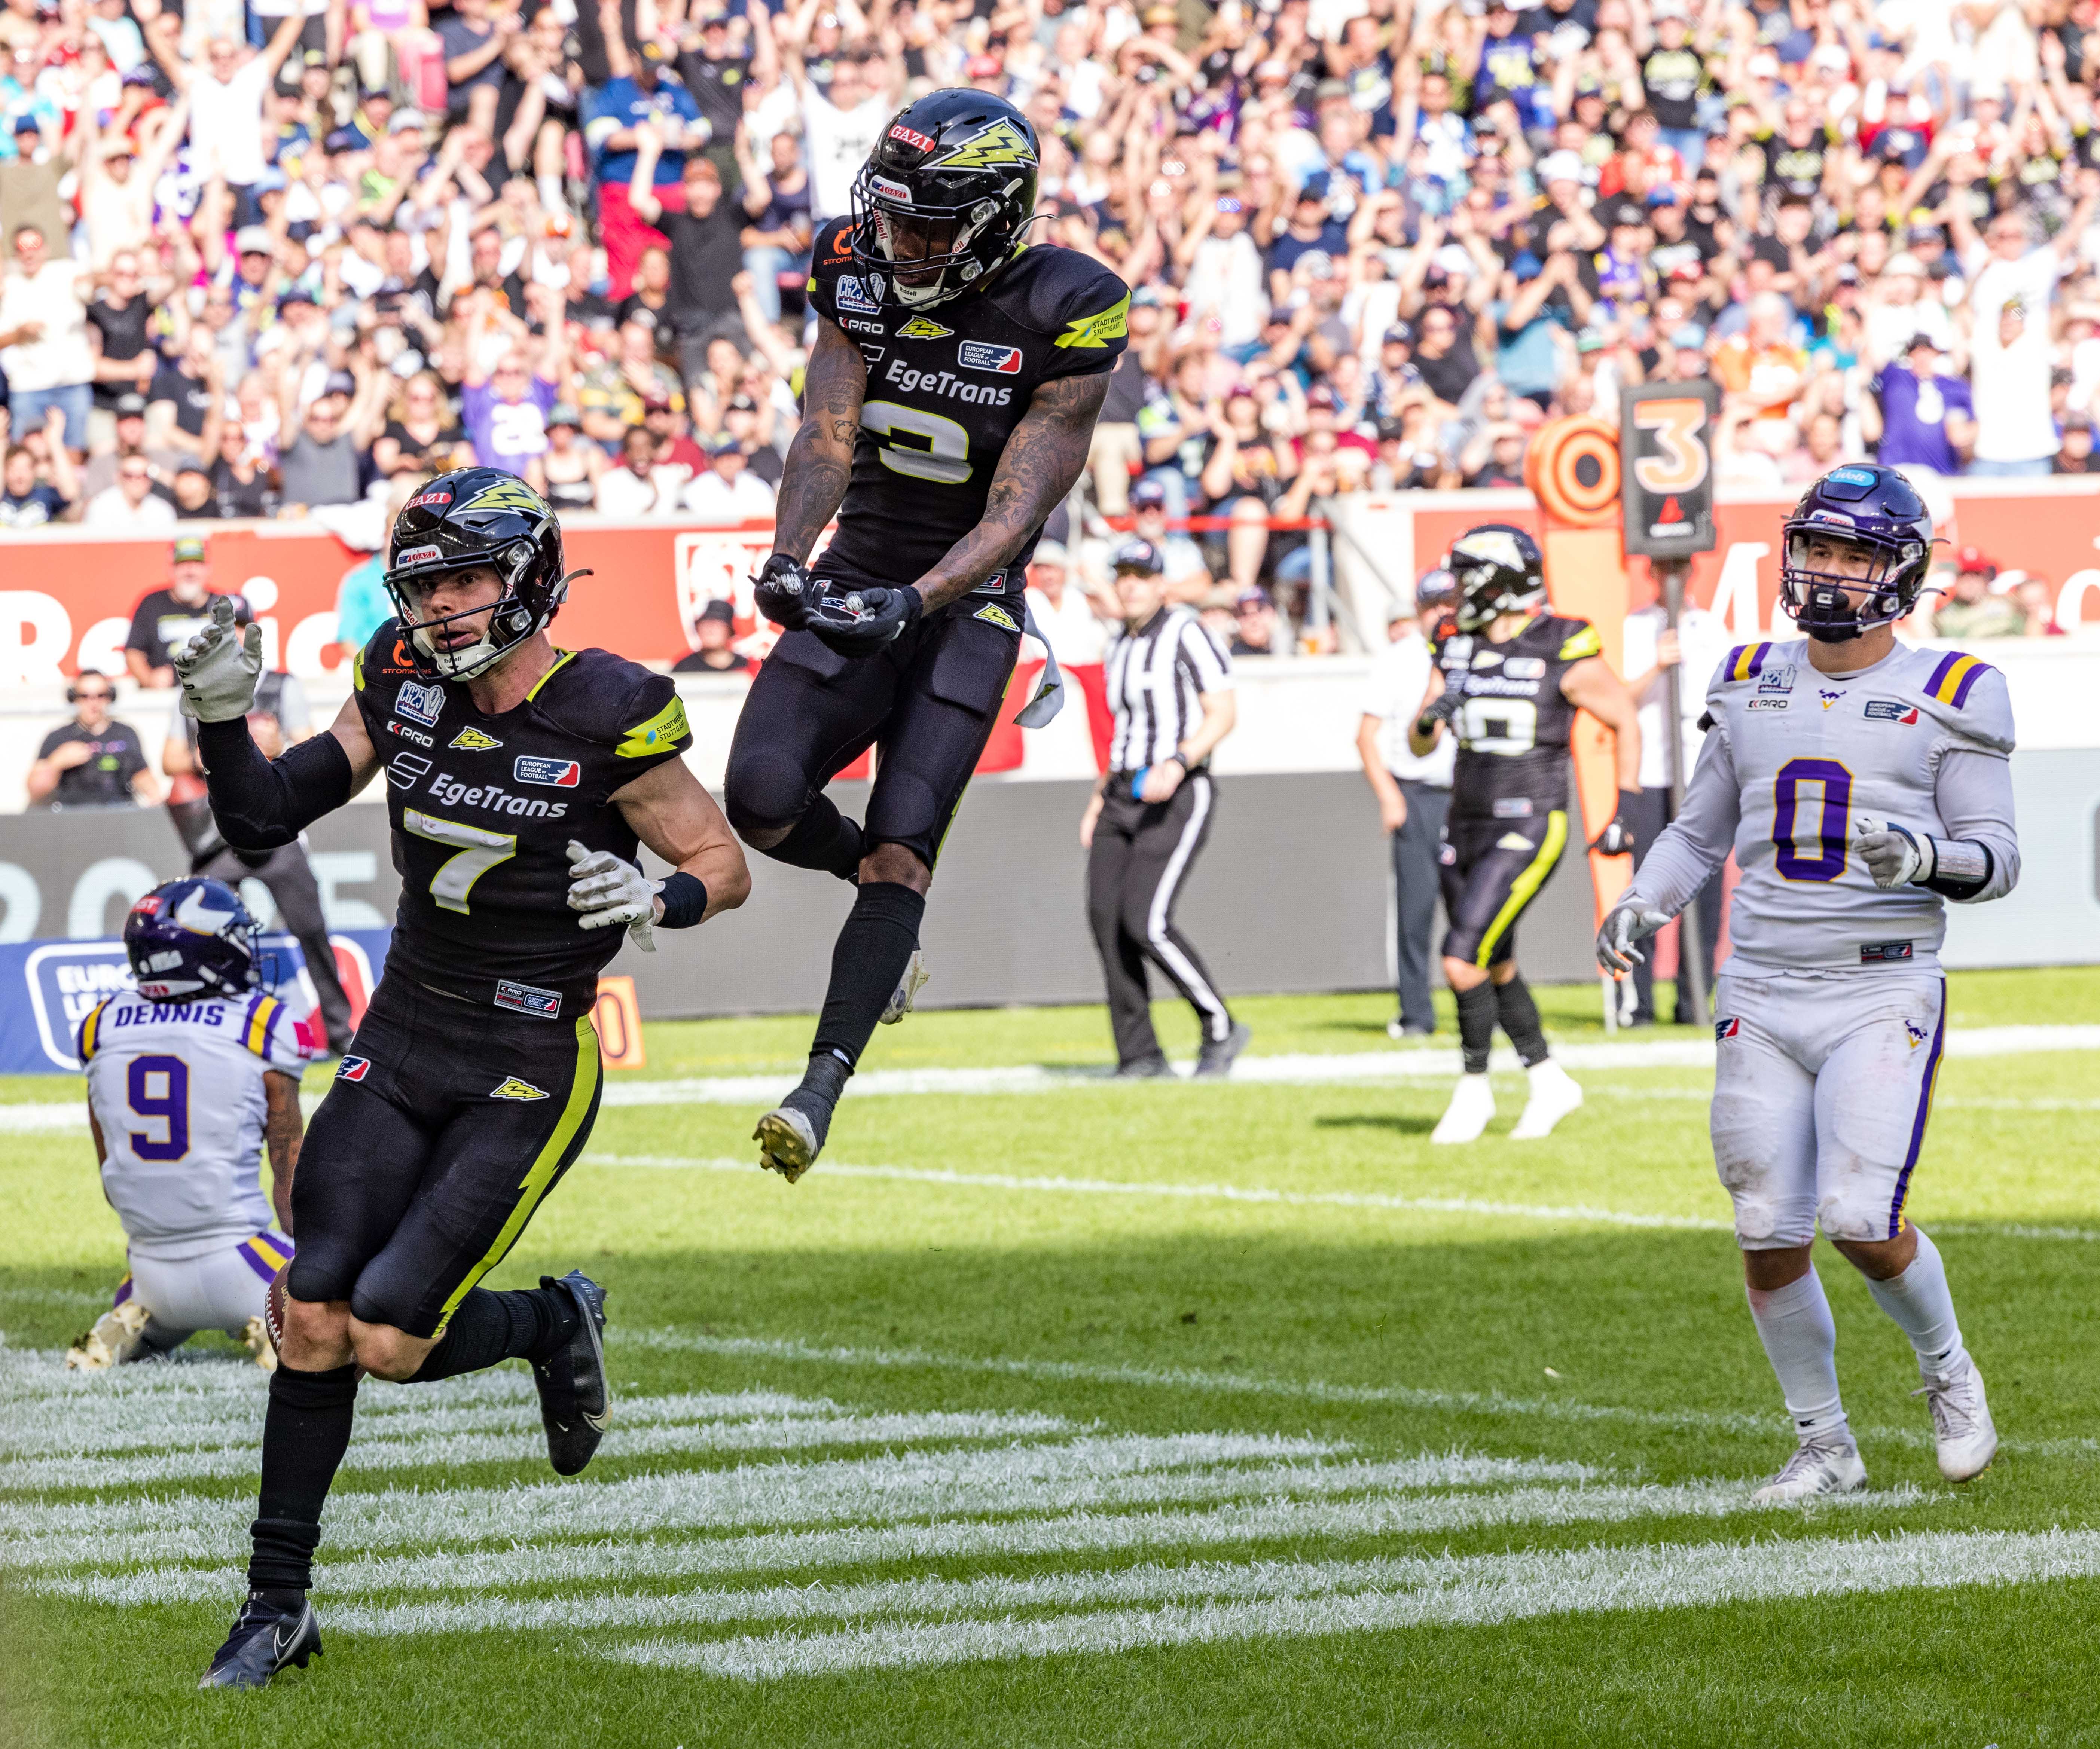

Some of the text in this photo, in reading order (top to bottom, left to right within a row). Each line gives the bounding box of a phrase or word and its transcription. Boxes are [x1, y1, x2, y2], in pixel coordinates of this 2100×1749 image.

[873, 207, 888, 240] iddell
[900, 287, 917, 296] Riddell
[1093, 312, 1124, 328] STADTWERKE
[1093, 322, 1120, 336] STUTTGART
[964, 357, 990, 366] FOOTBALL
[965, 346, 993, 355] EUROPEAN
[885, 359, 1013, 406] EgeTrans
[859, 400, 974, 484] 3
[1634, 398, 1709, 494] 3
[399, 683, 425, 709] CG25
[656, 711, 683, 733] STADTWERKE
[659, 720, 685, 741] STUTTGART
[428, 773, 568, 817] EgeTrans
[1773, 756, 1855, 883] 0
[404, 807, 517, 915] 7
[115, 1003, 226, 1028] DENNIS
[127, 1053, 190, 1164] 9
